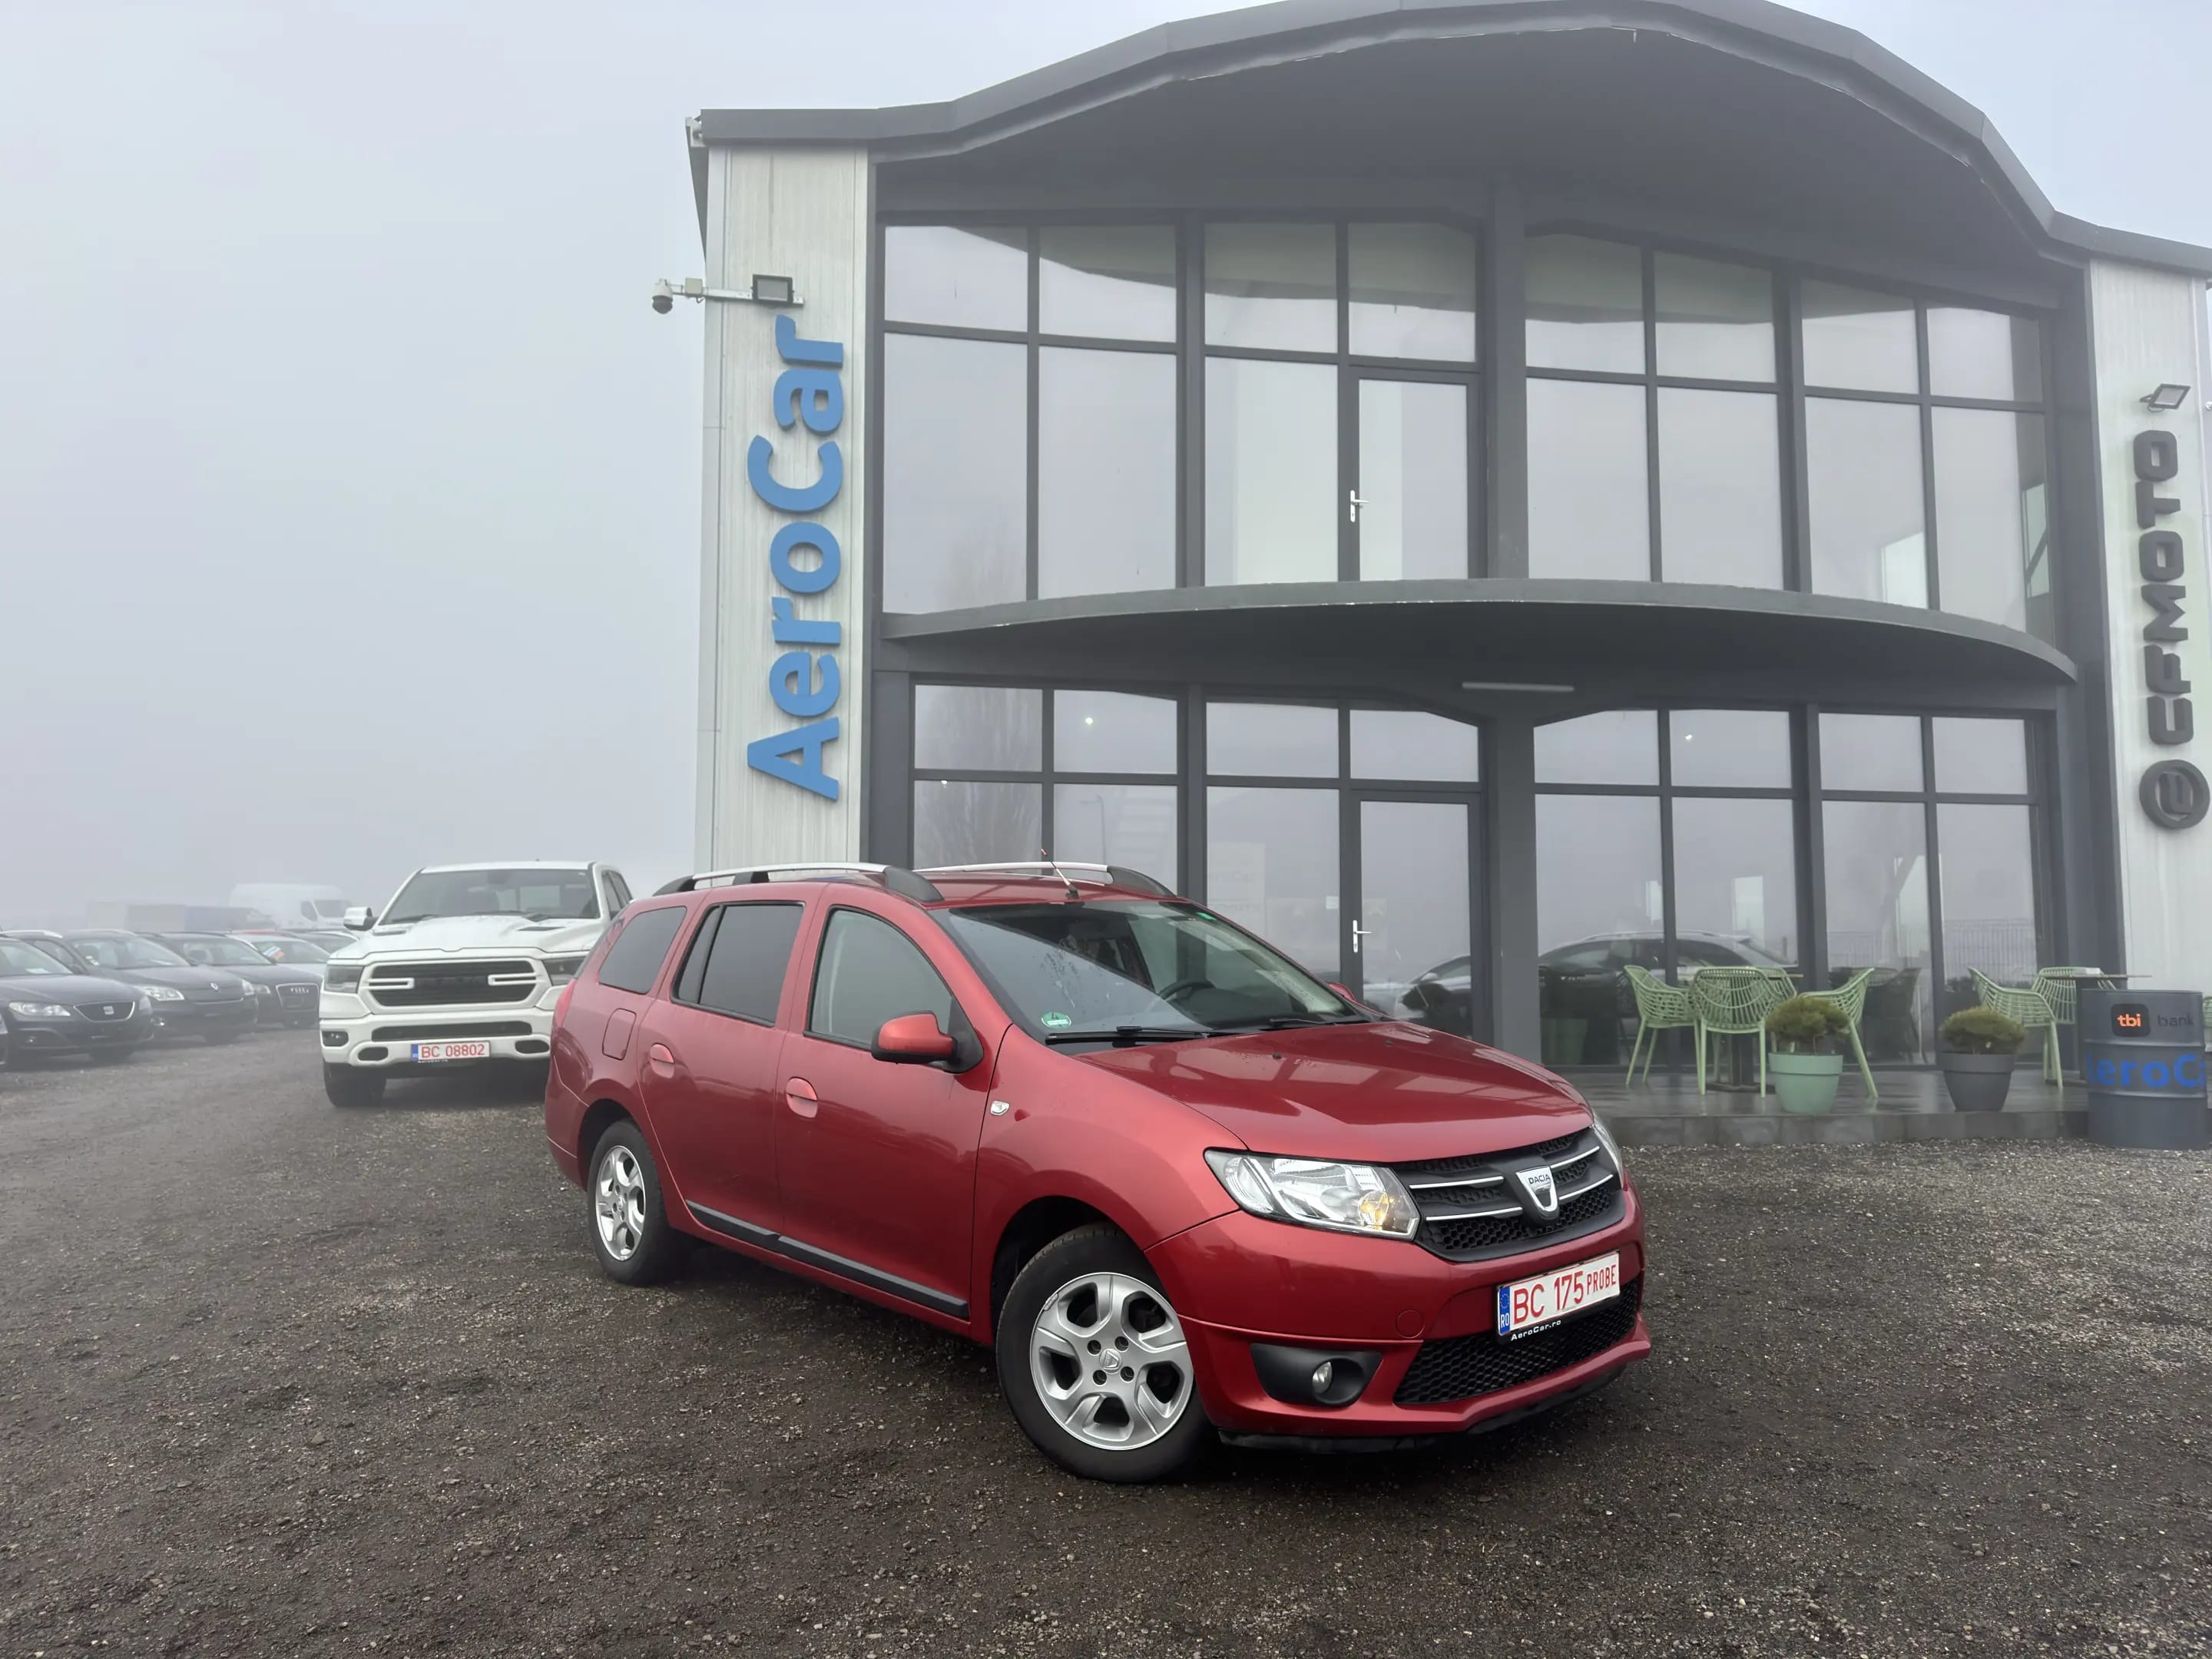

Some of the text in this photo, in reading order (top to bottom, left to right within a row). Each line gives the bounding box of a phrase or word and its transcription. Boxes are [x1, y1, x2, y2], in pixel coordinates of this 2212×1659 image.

[747, 314, 844, 801] AeroCar
[2133, 429, 2194, 745] CFMOTO
[2118, 1013, 2194, 1028] tbi bank
[421, 1044, 485, 1058] BC 08802
[1528, 1174, 1551, 1184] DACIA
[1513, 1264, 1617, 1326] BC 175 PROBE
[1500, 1313, 1510, 1329] RO
[1511, 1320, 1561, 1342] AeroCar.ro
